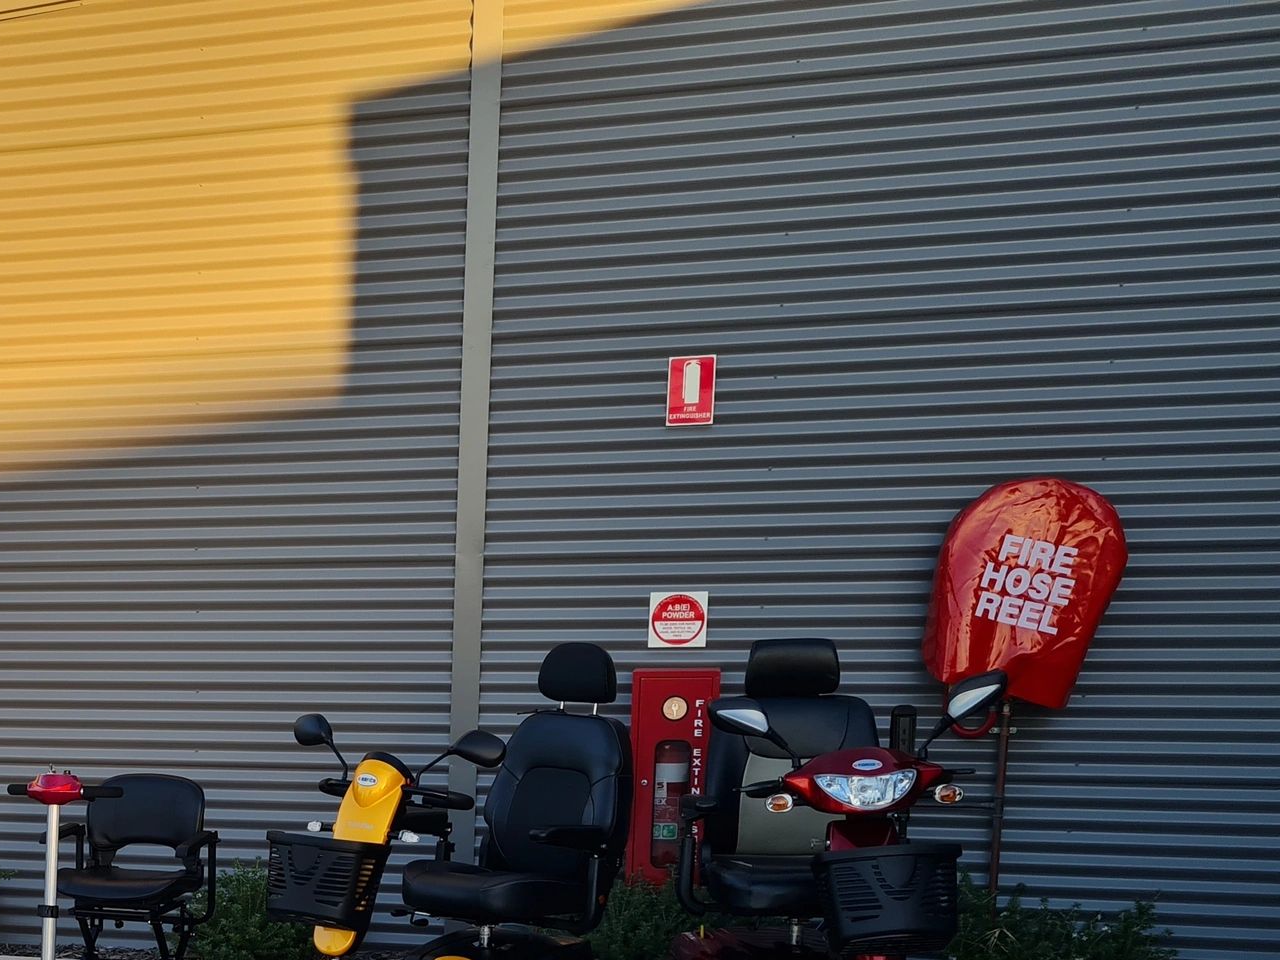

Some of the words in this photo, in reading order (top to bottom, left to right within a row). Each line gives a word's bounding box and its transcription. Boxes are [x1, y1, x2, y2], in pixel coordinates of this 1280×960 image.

[998, 533, 1079, 576] FIRE
[980, 561, 1076, 606] HOSE
[975, 591, 1058, 635] REEL
[693, 699, 705, 737] FIRE
